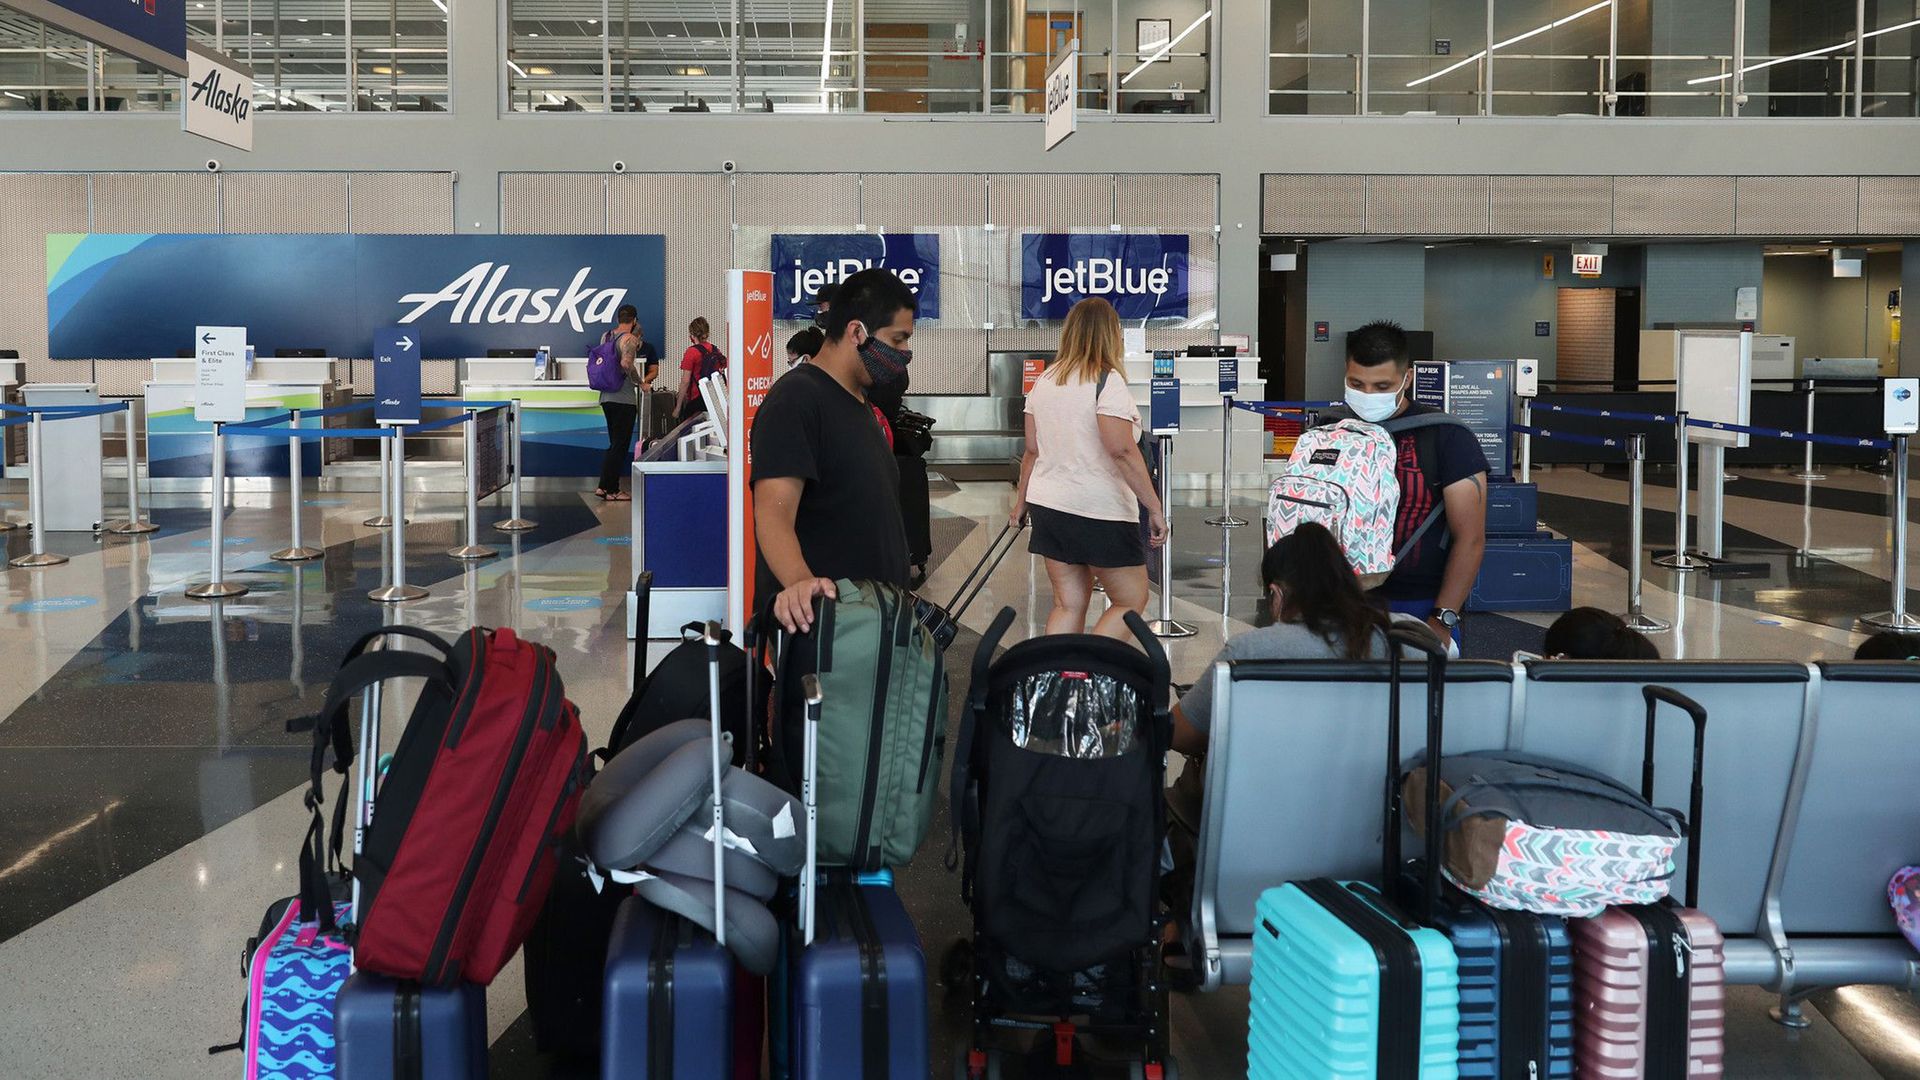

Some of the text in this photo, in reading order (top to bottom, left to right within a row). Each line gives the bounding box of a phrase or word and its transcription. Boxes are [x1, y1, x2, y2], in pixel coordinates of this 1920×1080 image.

[191, 69, 250, 123] Alaska
[1042, 258, 1169, 303] jetBlue
[1576, 256, 1599, 270] EXIT
[397, 262, 628, 332] Alaska
[746, 290, 766, 303] jetBlue
